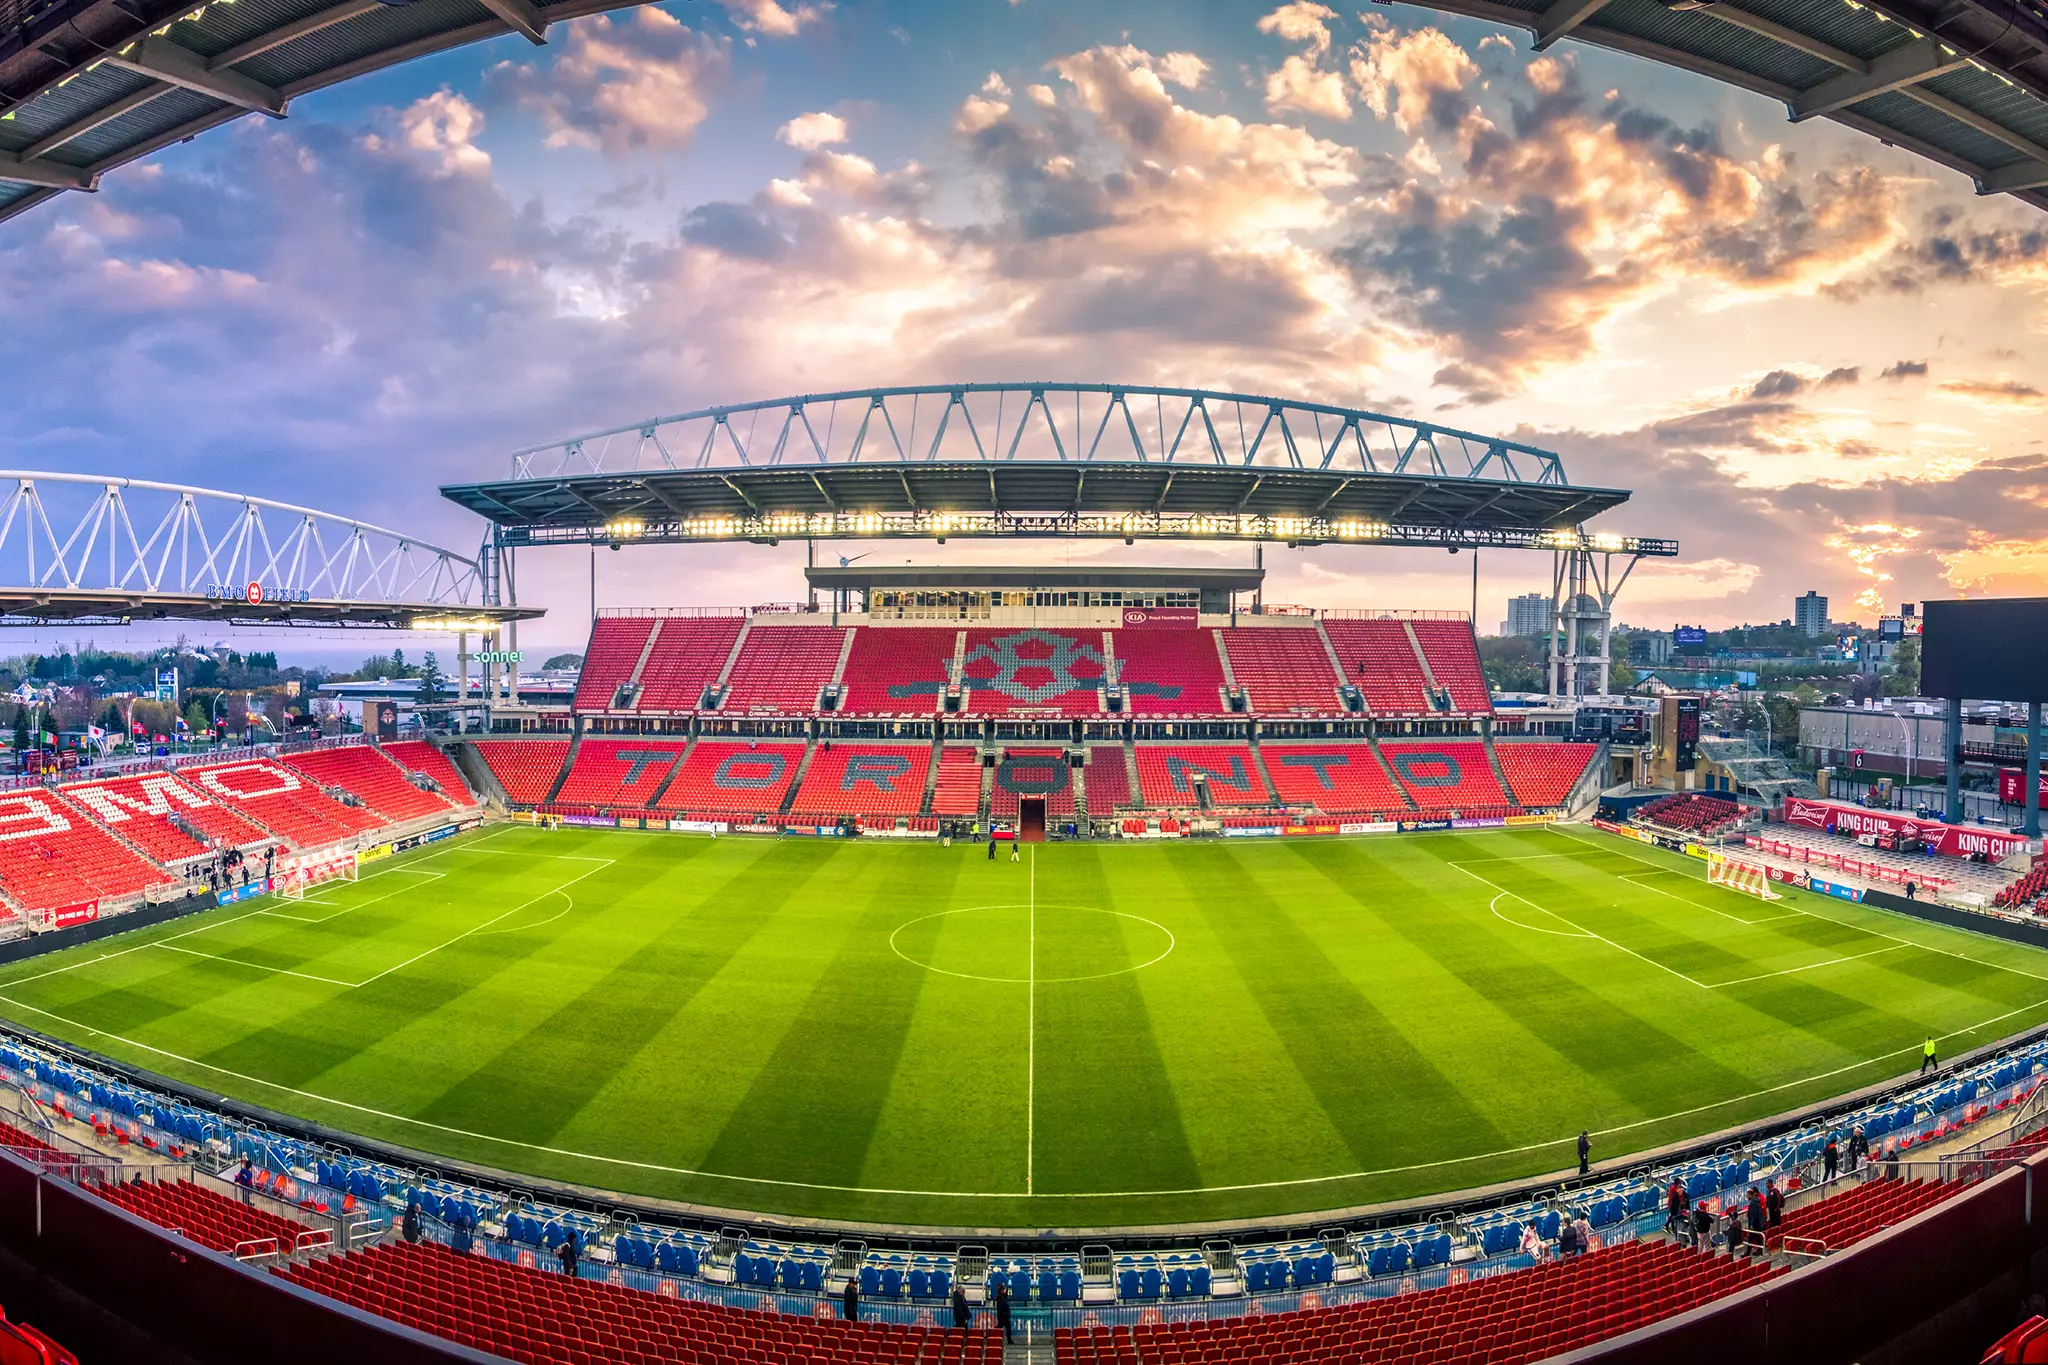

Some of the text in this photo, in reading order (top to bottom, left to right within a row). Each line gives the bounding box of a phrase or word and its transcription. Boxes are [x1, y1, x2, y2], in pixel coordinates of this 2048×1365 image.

[208, 584, 310, 602] BMO FIELD
[472, 650, 525, 663] sonnet
[1857, 755, 1862, 767] 6
[1792, 804, 1826, 820] Budweiser
[1837, 812, 1861, 831] KING
[1958, 833, 1987, 854] KING
